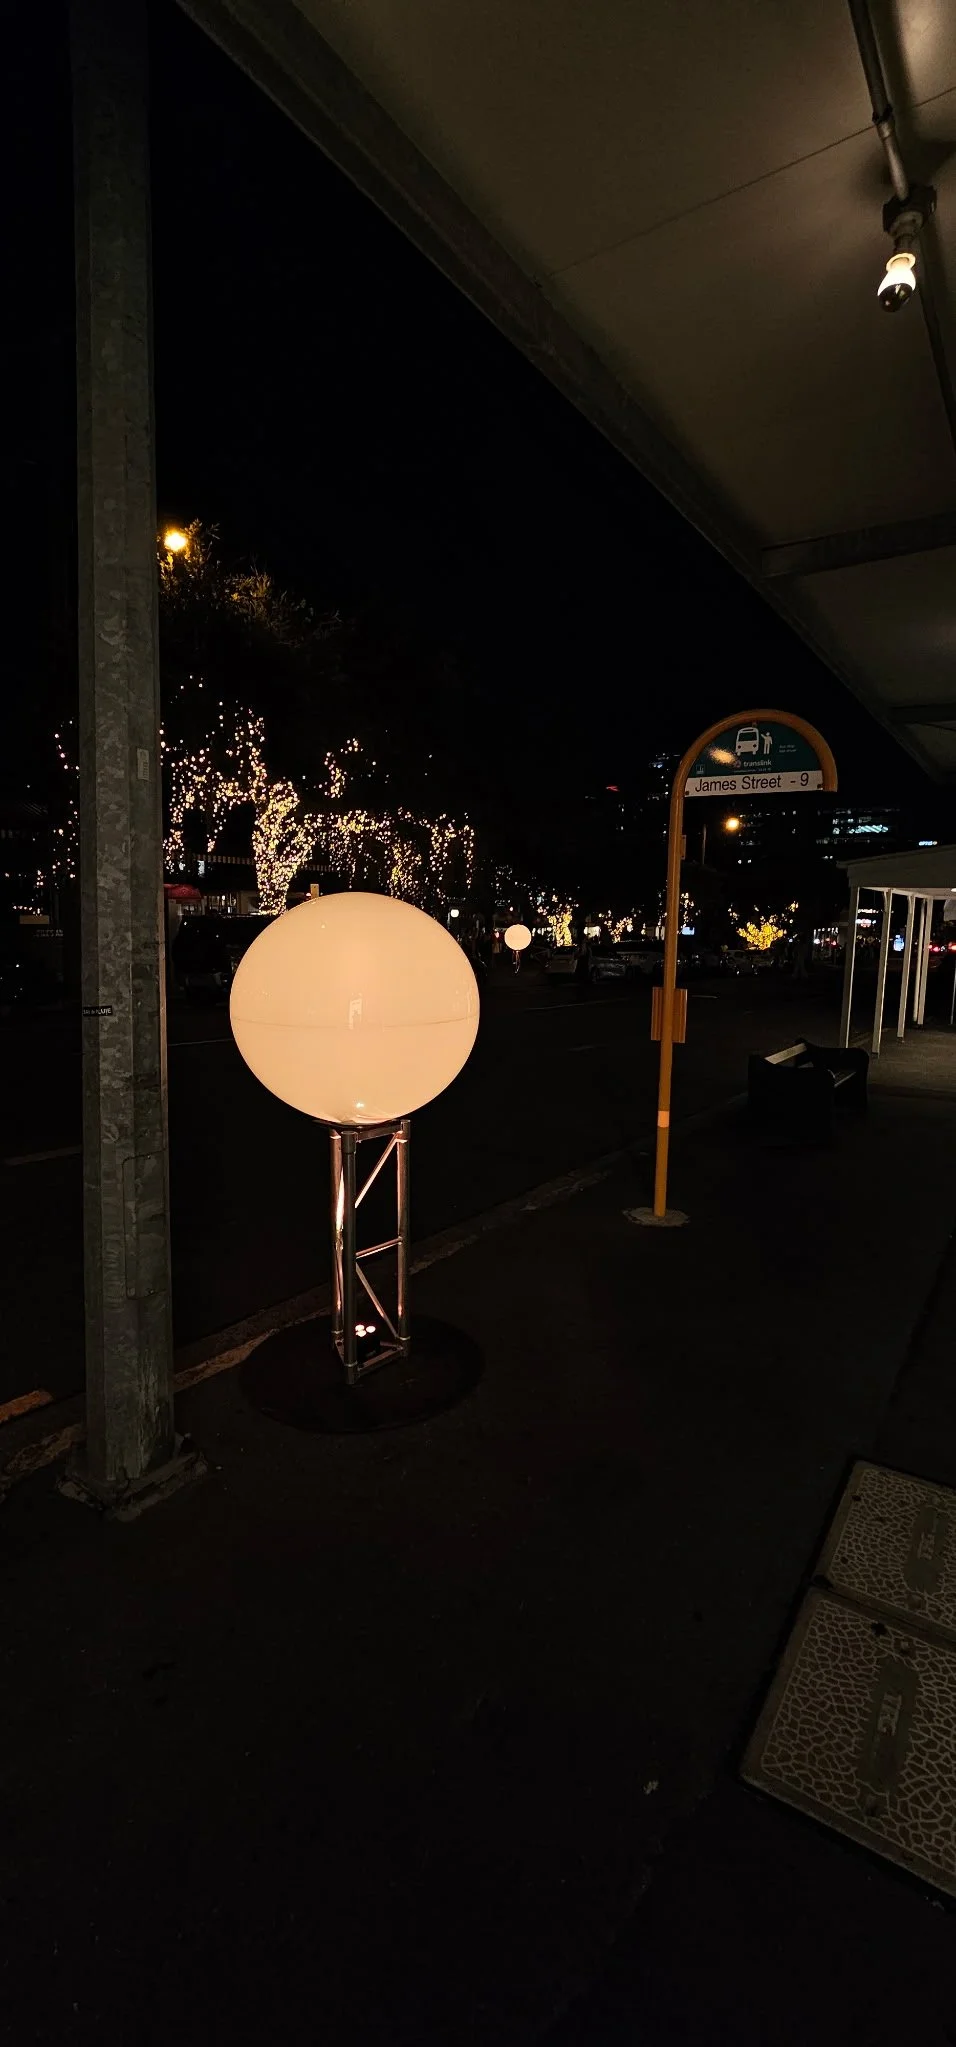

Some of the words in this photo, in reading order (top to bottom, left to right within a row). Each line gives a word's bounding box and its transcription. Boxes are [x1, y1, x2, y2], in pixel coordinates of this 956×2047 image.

[743, 759, 772, 767] translink
[695, 779, 736, 792] James
[741, 775, 781, 789] Street
[800, 772, 809, 786] 9
